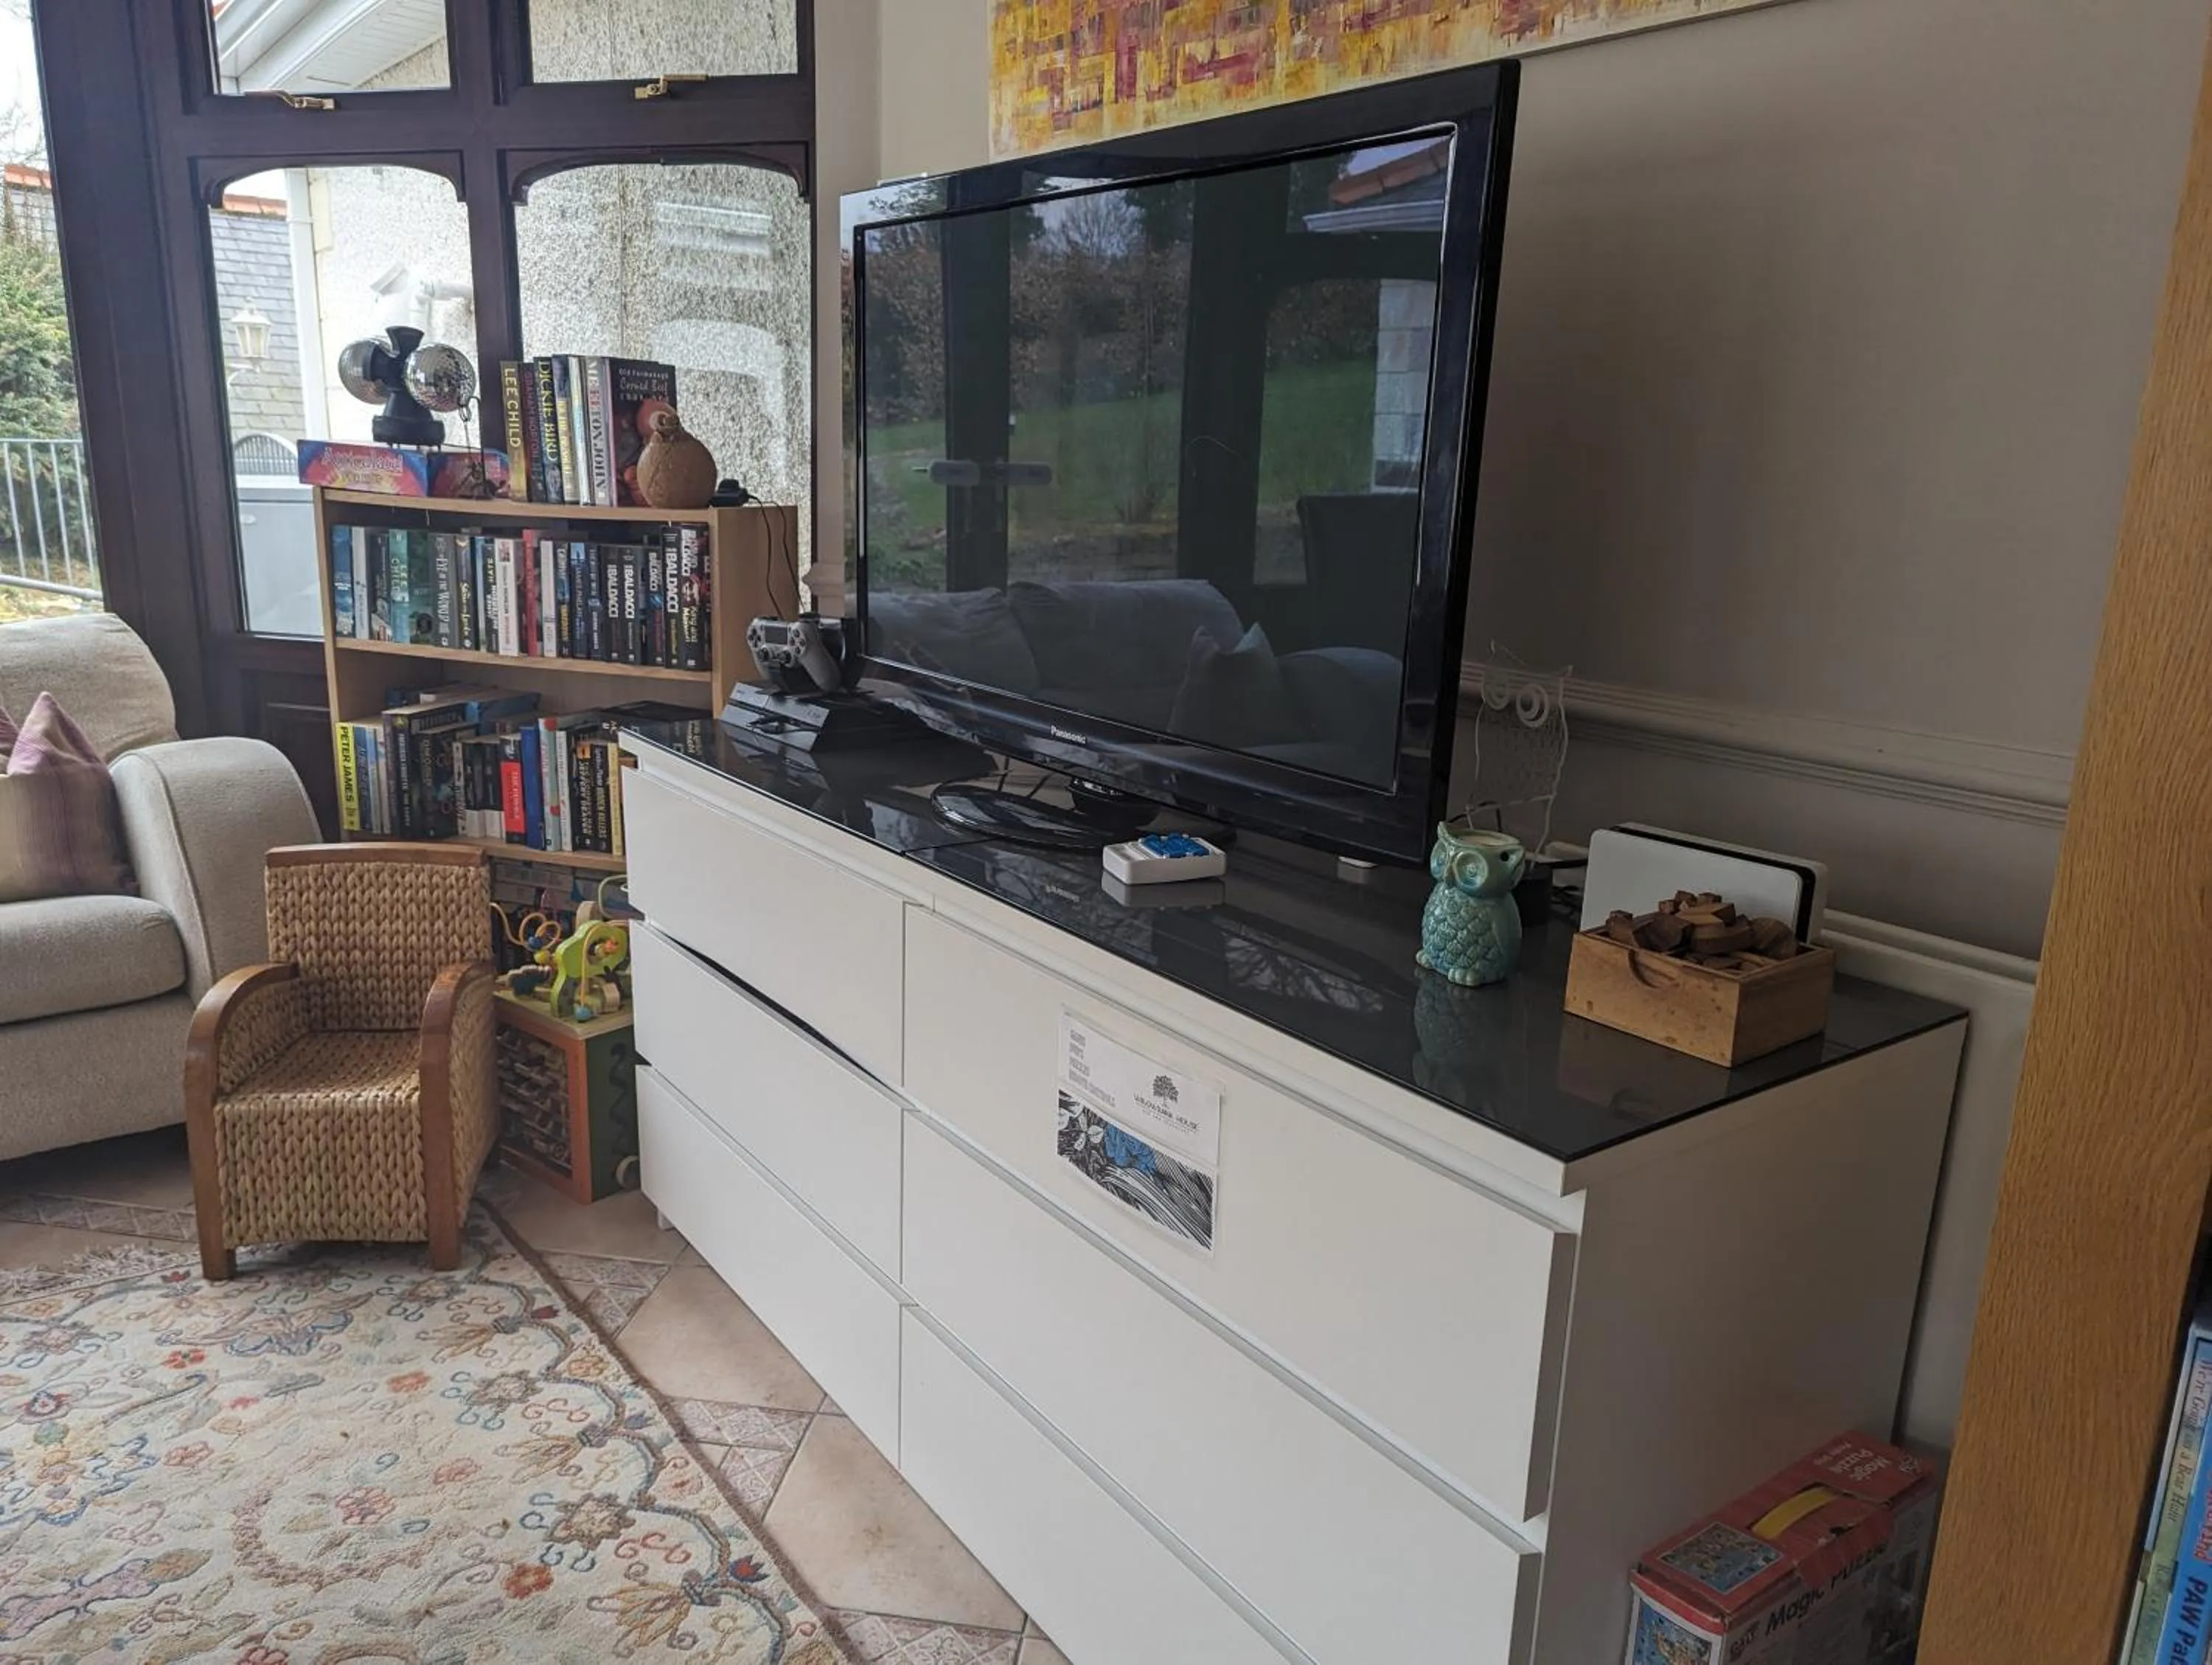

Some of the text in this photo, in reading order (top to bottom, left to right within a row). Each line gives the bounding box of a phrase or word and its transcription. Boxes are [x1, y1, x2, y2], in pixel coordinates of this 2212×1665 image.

[504, 368, 521, 448] LEE CHILD
[538, 361, 559, 462] DICKIE BIRD
[592, 443, 607, 488] JOHN
[649, 552, 658, 591] BALDACCI
[681, 529, 692, 577] BALDACCI
[608, 568, 619, 618] BALDACCI
[624, 569, 635, 619] BALDACCI
[666, 552, 678, 613] BALDACCI
[340, 726, 355, 802] PETER JAMES
[2174, 1463, 2194, 1491] Bear
[2168, 1492, 2187, 1523] Hunt
[1765, 1588, 1825, 1636] Magic
[2180, 1576, 2209, 1629] PAW
